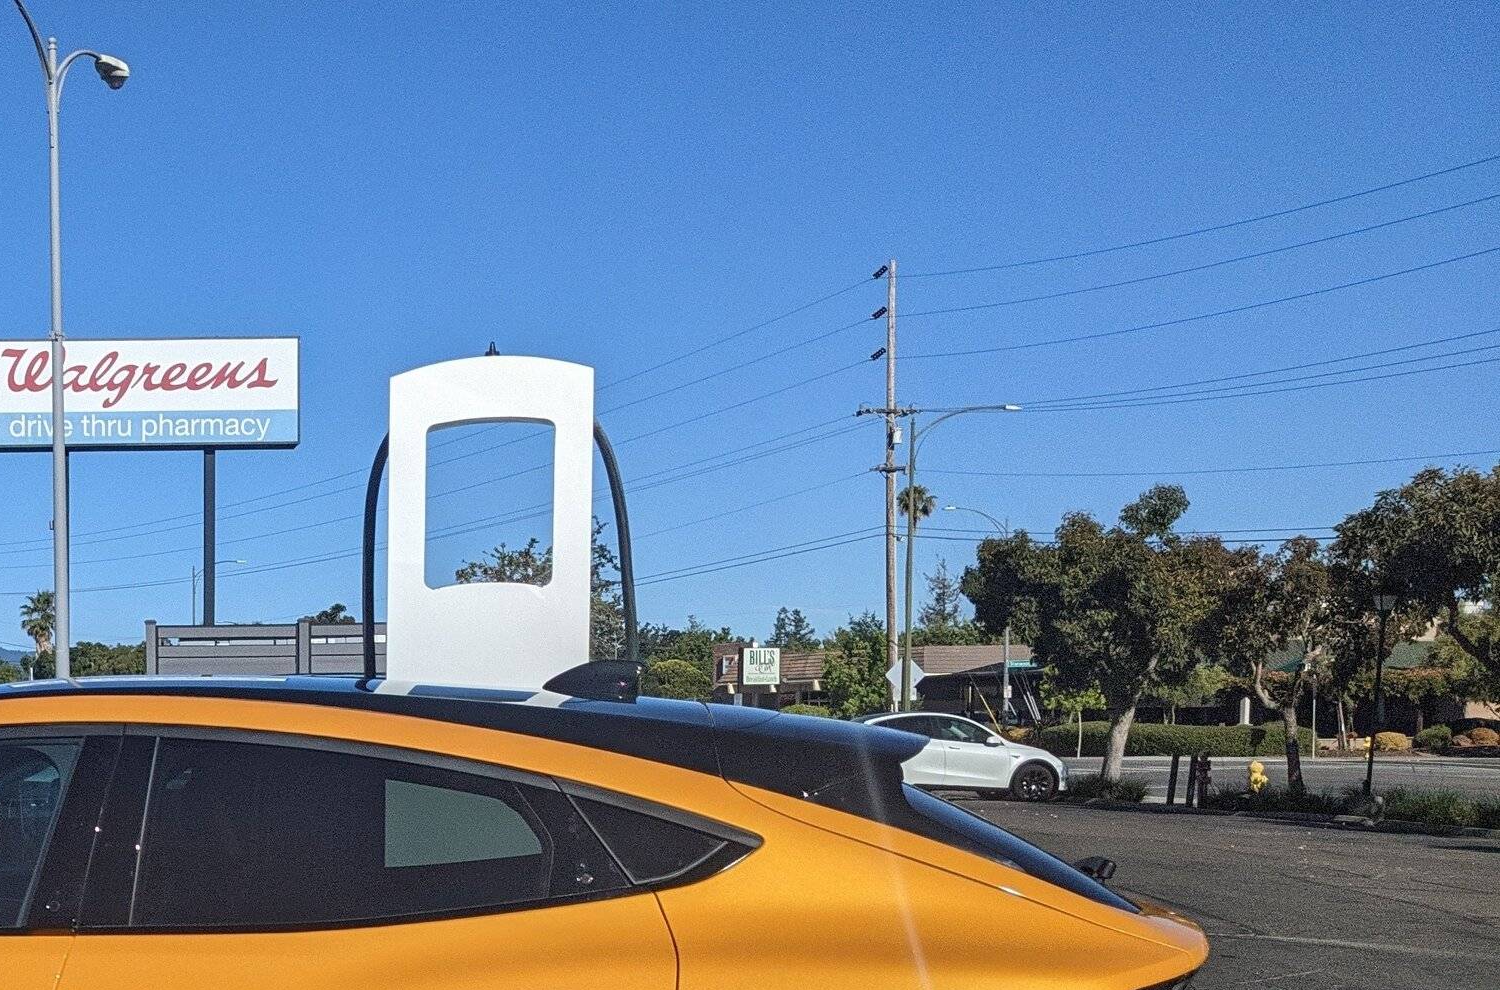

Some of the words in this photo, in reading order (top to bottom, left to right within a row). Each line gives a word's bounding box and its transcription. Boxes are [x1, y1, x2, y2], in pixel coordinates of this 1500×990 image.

[1, 345, 278, 408] Walgreens
[83, 414, 132, 438] thru
[142, 413, 270, 442] pharmacy
[750, 650, 775, 667] BILL'S
